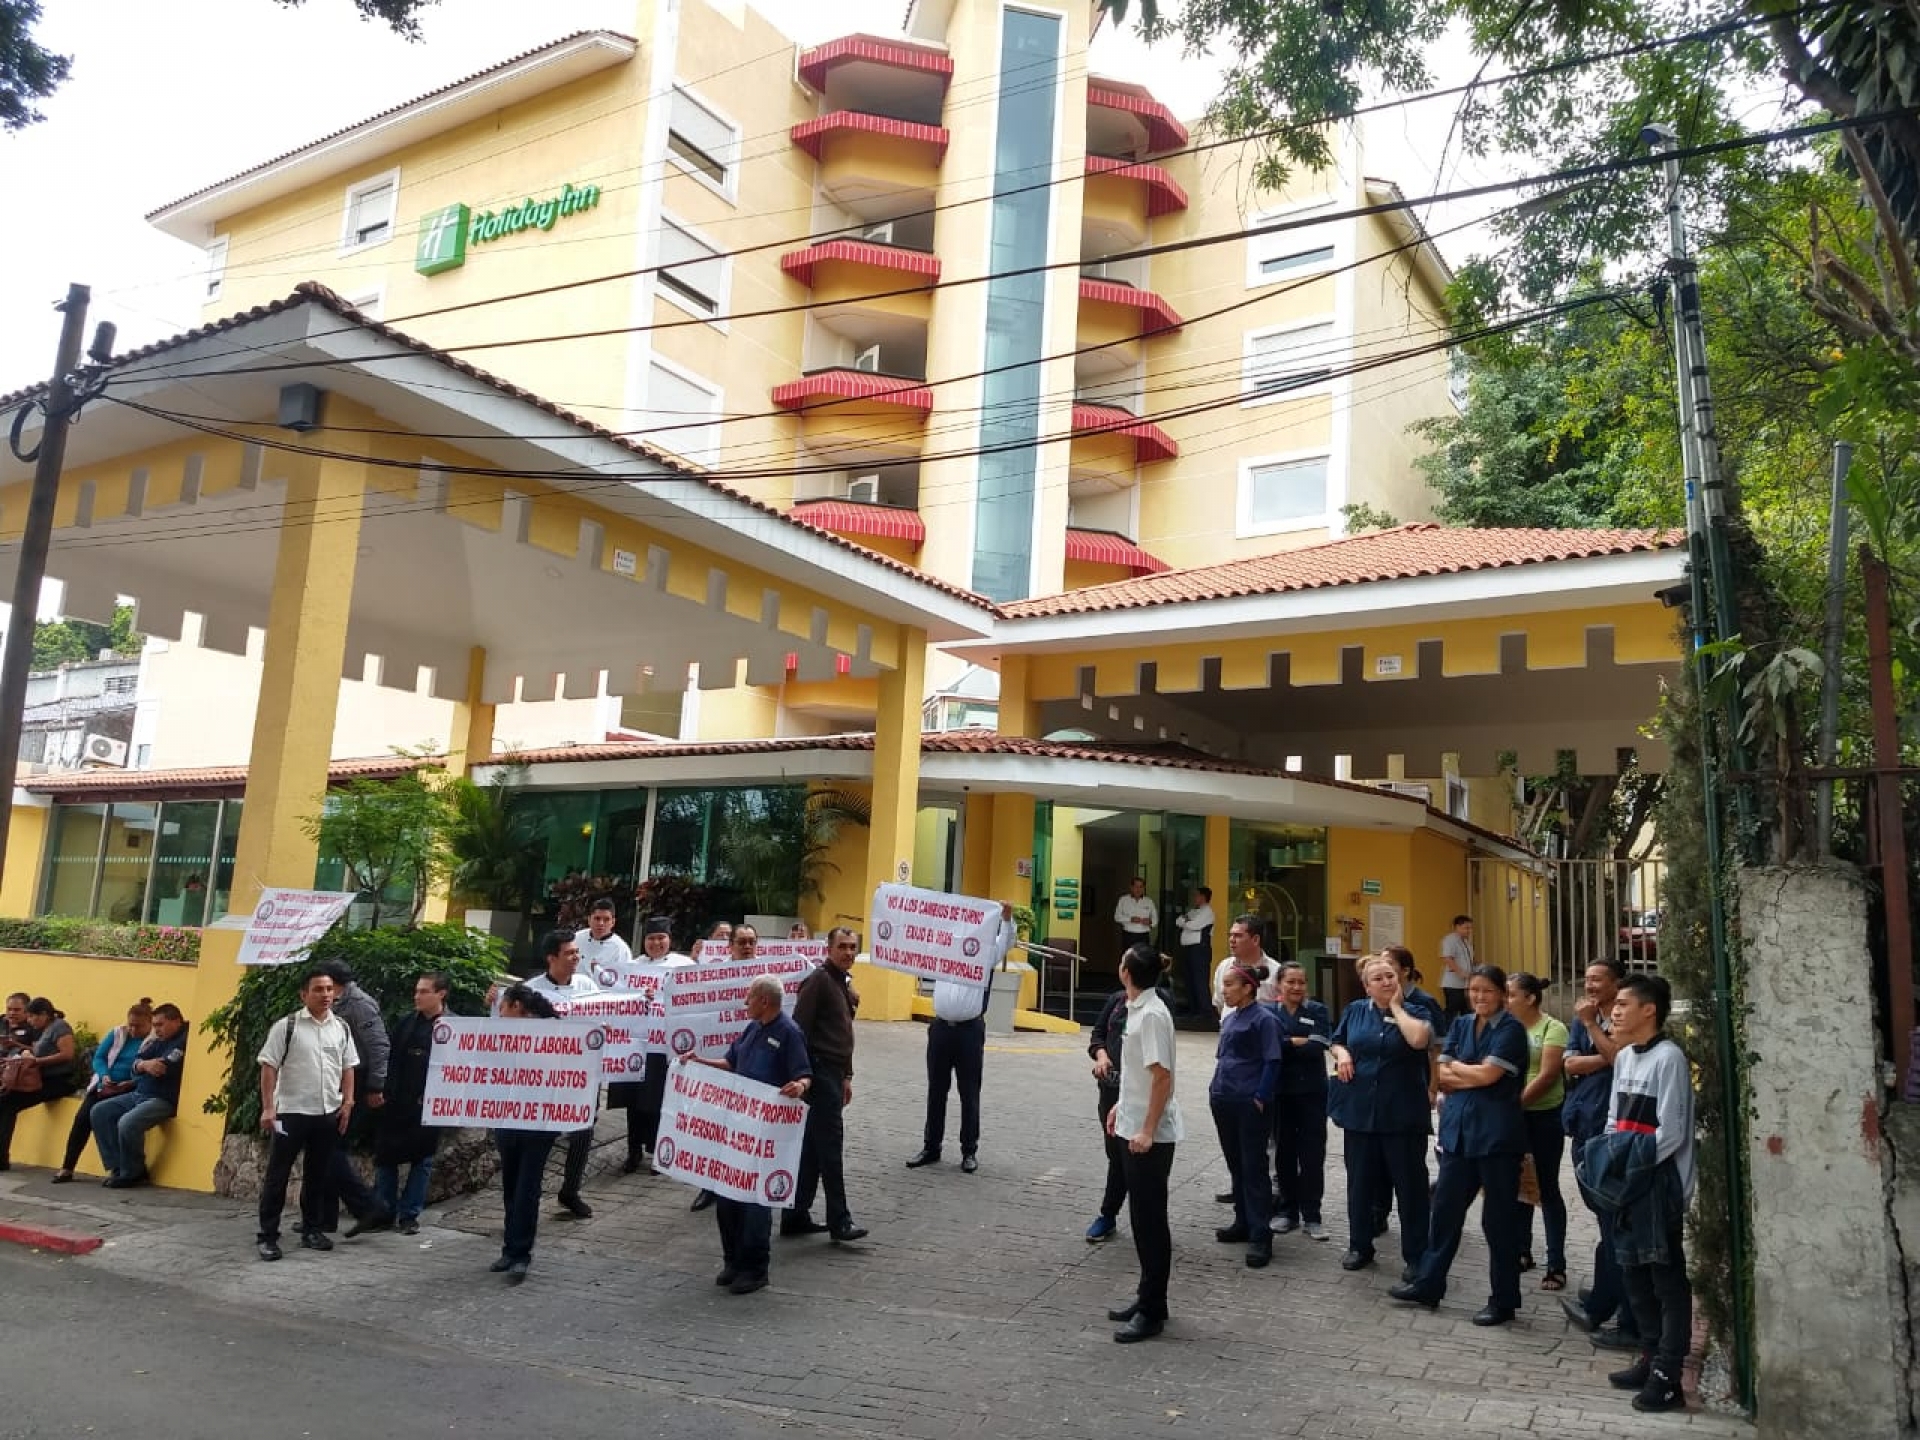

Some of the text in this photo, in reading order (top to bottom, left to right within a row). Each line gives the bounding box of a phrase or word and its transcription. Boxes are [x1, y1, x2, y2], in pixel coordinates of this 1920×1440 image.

[470, 182, 601, 247] Holiday Inn
[888, 896, 898, 910] NO
[904, 898, 918, 912] LOS
[949, 906, 960, 921] DE
[961, 908, 985, 925] TURNO
[875, 944, 883, 960] NO
[901, 950, 938, 972] CONTRATOS
[939, 958, 984, 981] TEMPORALES
[571, 999, 649, 1017] INJUSTIFICADOS
[671, 992, 706, 1007] NOSOTROS
[707, 990, 716, 1003] NO
[458, 1033, 583, 1056] NO MALTRATO LABORAL
[473, 1066, 488, 1084] DE
[490, 1067, 543, 1088] SALARIOS
[545, 1070, 587, 1089] JUSTOS
[432, 1097, 590, 1123] EXIJO MI EQUIPO DE TRABAJO
[749, 1098, 760, 1118] DE
[760, 1102, 804, 1125] PROPINAS
[688, 1115, 728, 1146] PERSONAL
[764, 1139, 775, 1158] EL
[695, 1154, 708, 1176] DE
[708, 1157, 759, 1192] RESTAURANT
